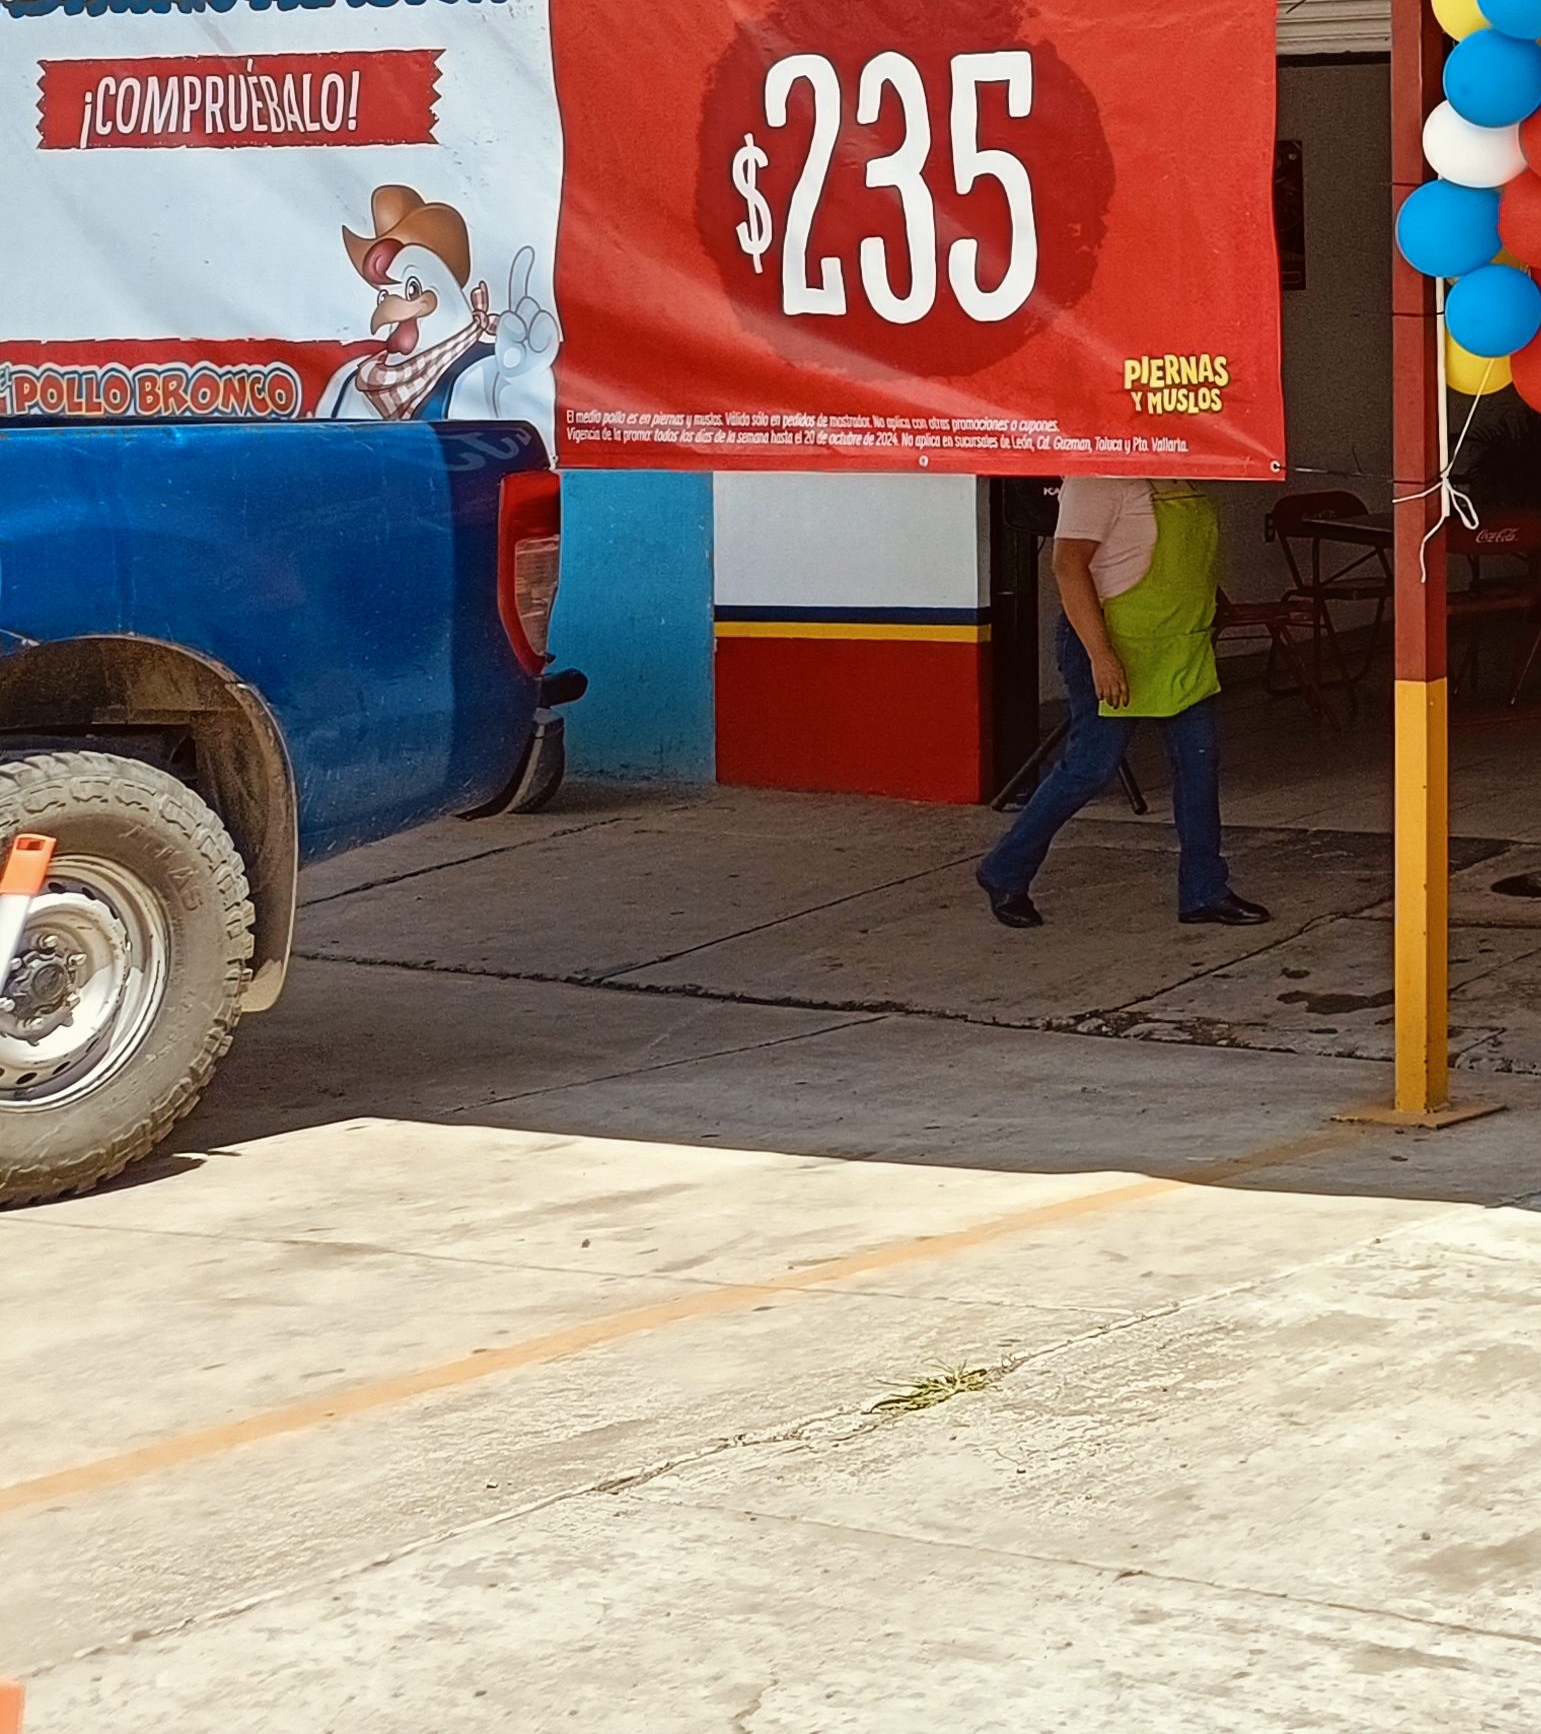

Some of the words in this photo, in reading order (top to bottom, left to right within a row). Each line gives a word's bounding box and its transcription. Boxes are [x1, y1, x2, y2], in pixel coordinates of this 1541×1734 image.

[81, 57, 360, 149] ¡COMPRUÉBALO!
[732, 50, 1038, 325] $235
[13, 369, 130, 417] POLLO
[135, 368, 296, 418] BRONCO
[1123, 353, 1230, 390] PIERNAS
[1131, 391, 1143, 412] Y
[1147, 386, 1223, 415] MUSLOS
[804, 431, 815, 445] 20
